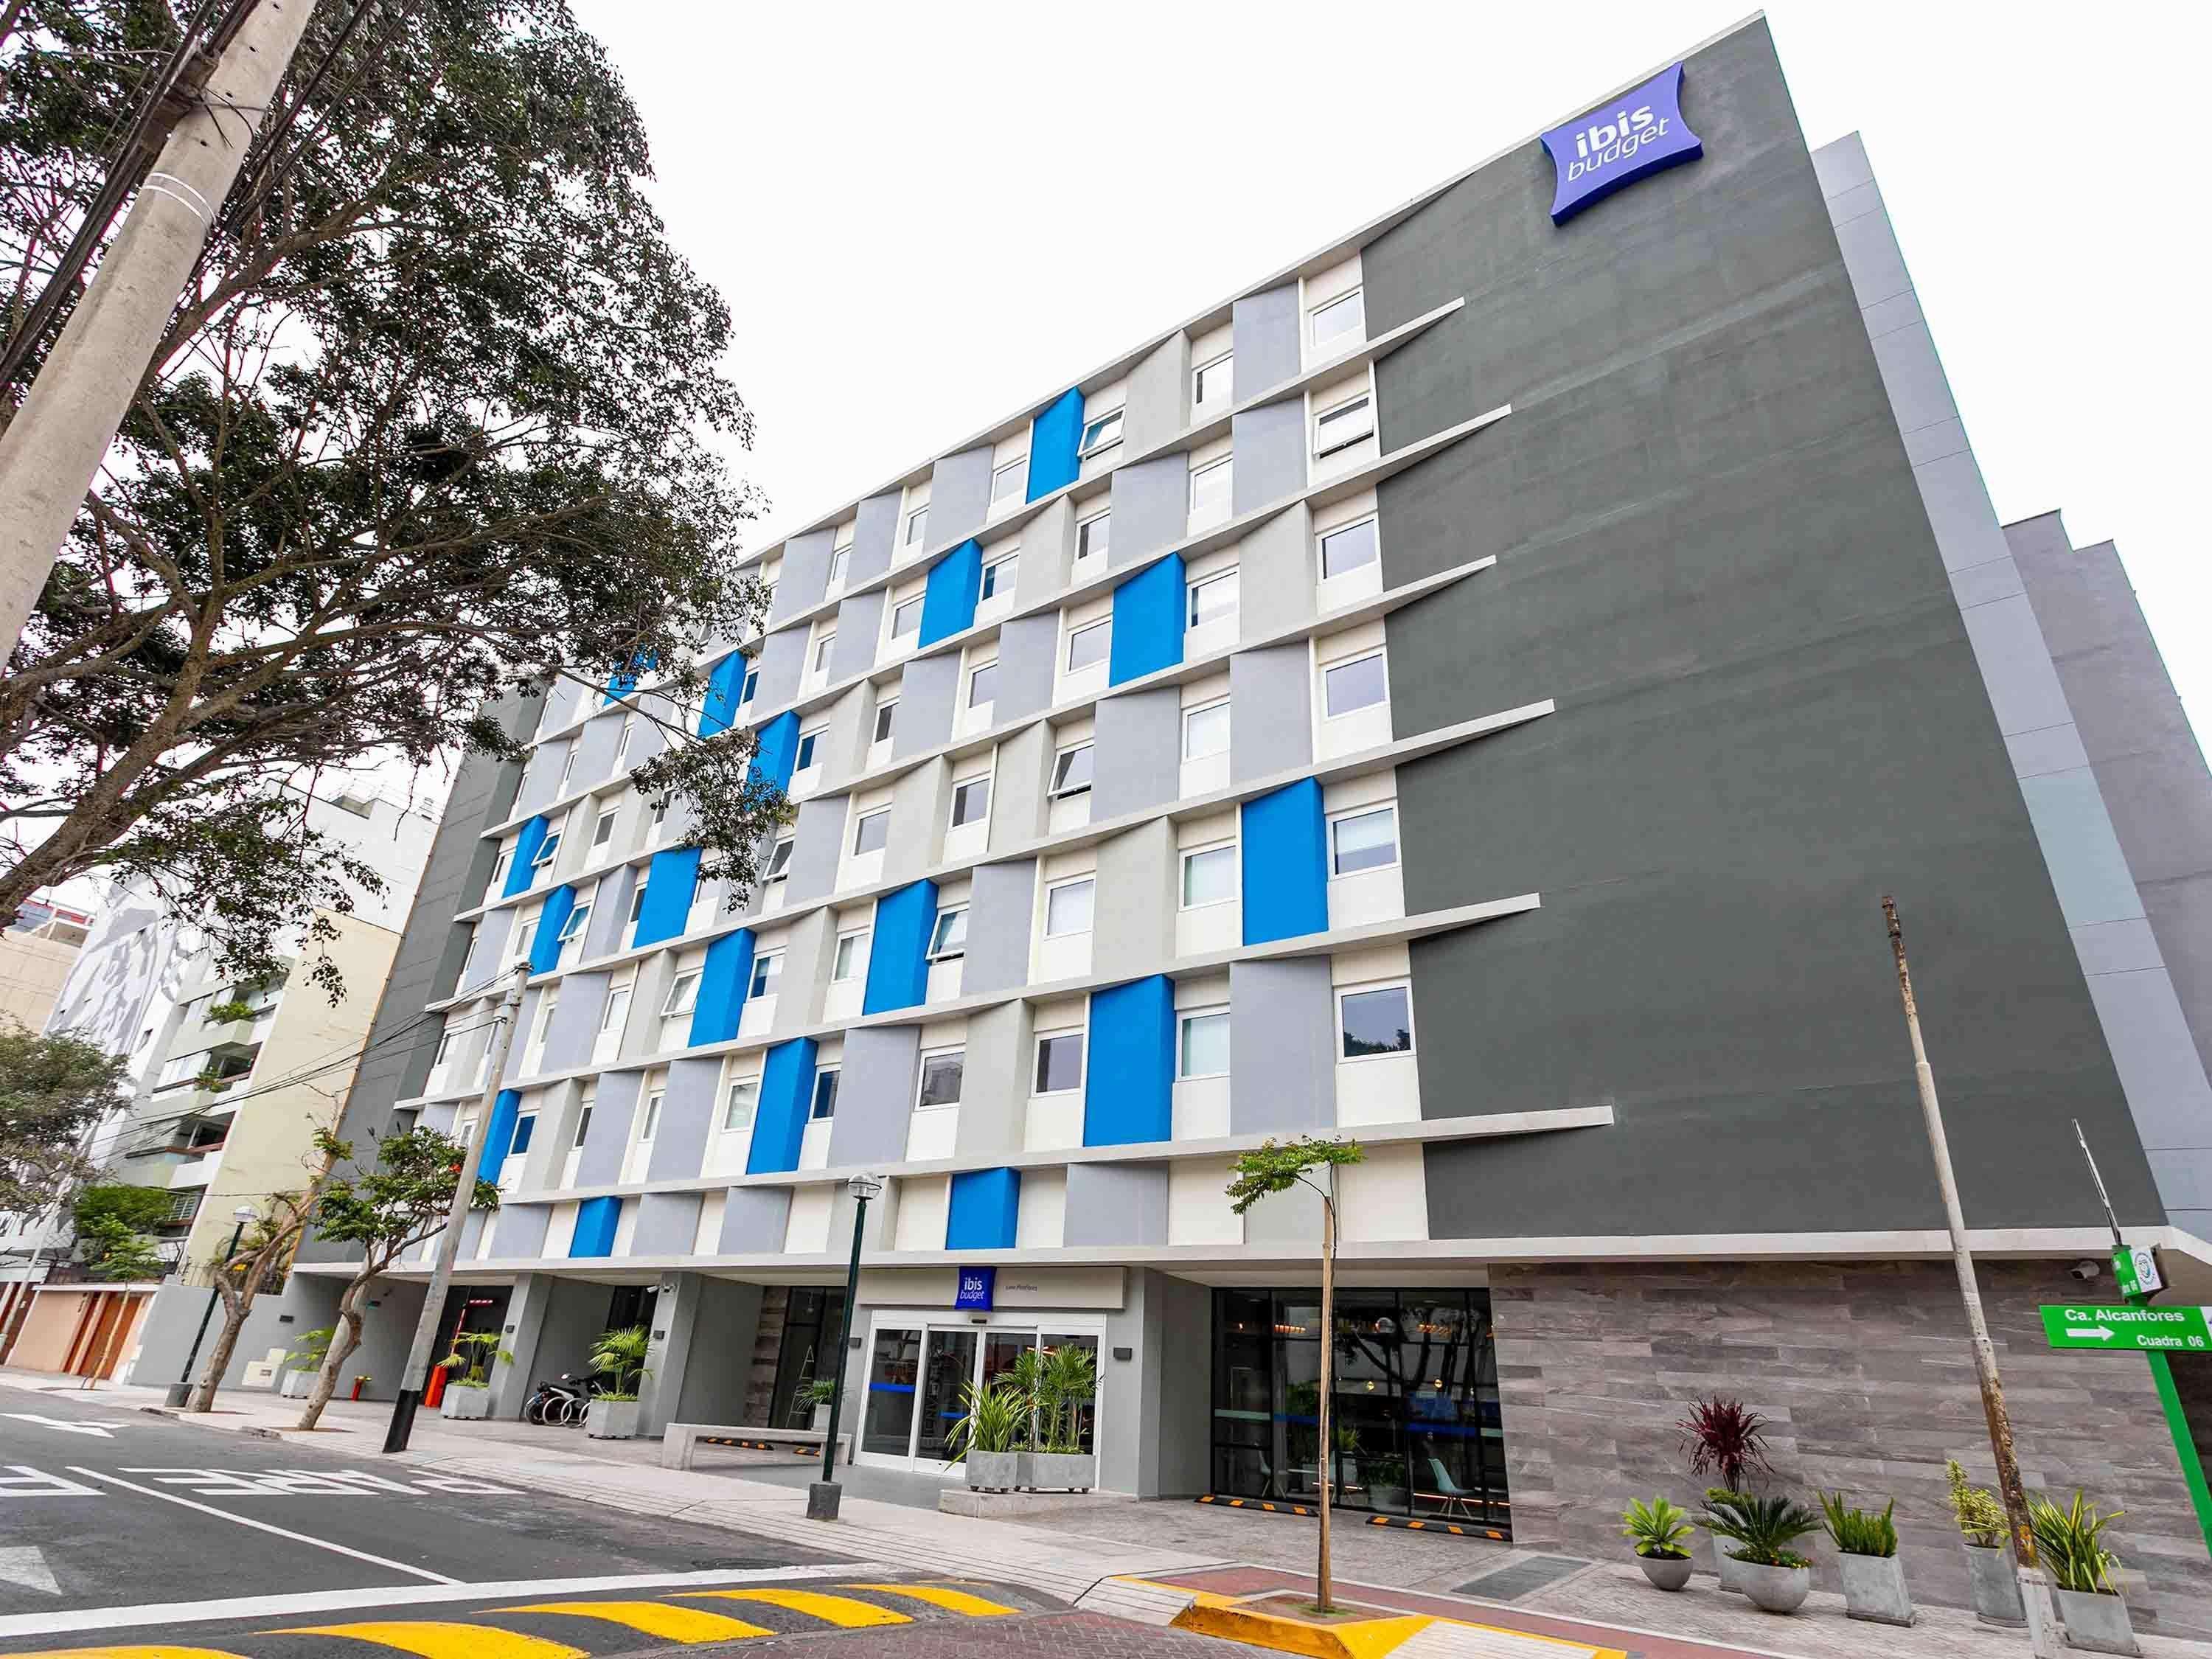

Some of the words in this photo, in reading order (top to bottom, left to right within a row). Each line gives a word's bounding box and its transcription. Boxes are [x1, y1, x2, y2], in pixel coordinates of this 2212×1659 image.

[1576, 105, 1654, 159] ibis
[1568, 117, 1669, 182] budget
[964, 1276, 983, 1290] ibis
[960, 1290, 984, 1302] budget
[2065, 1309, 2093, 1321] Ca.
[2096, 1309, 2185, 1321] Alcanfores
[2137, 1335, 2183, 1346] Cuadra
[2188, 1335, 2204, 1347] 06
